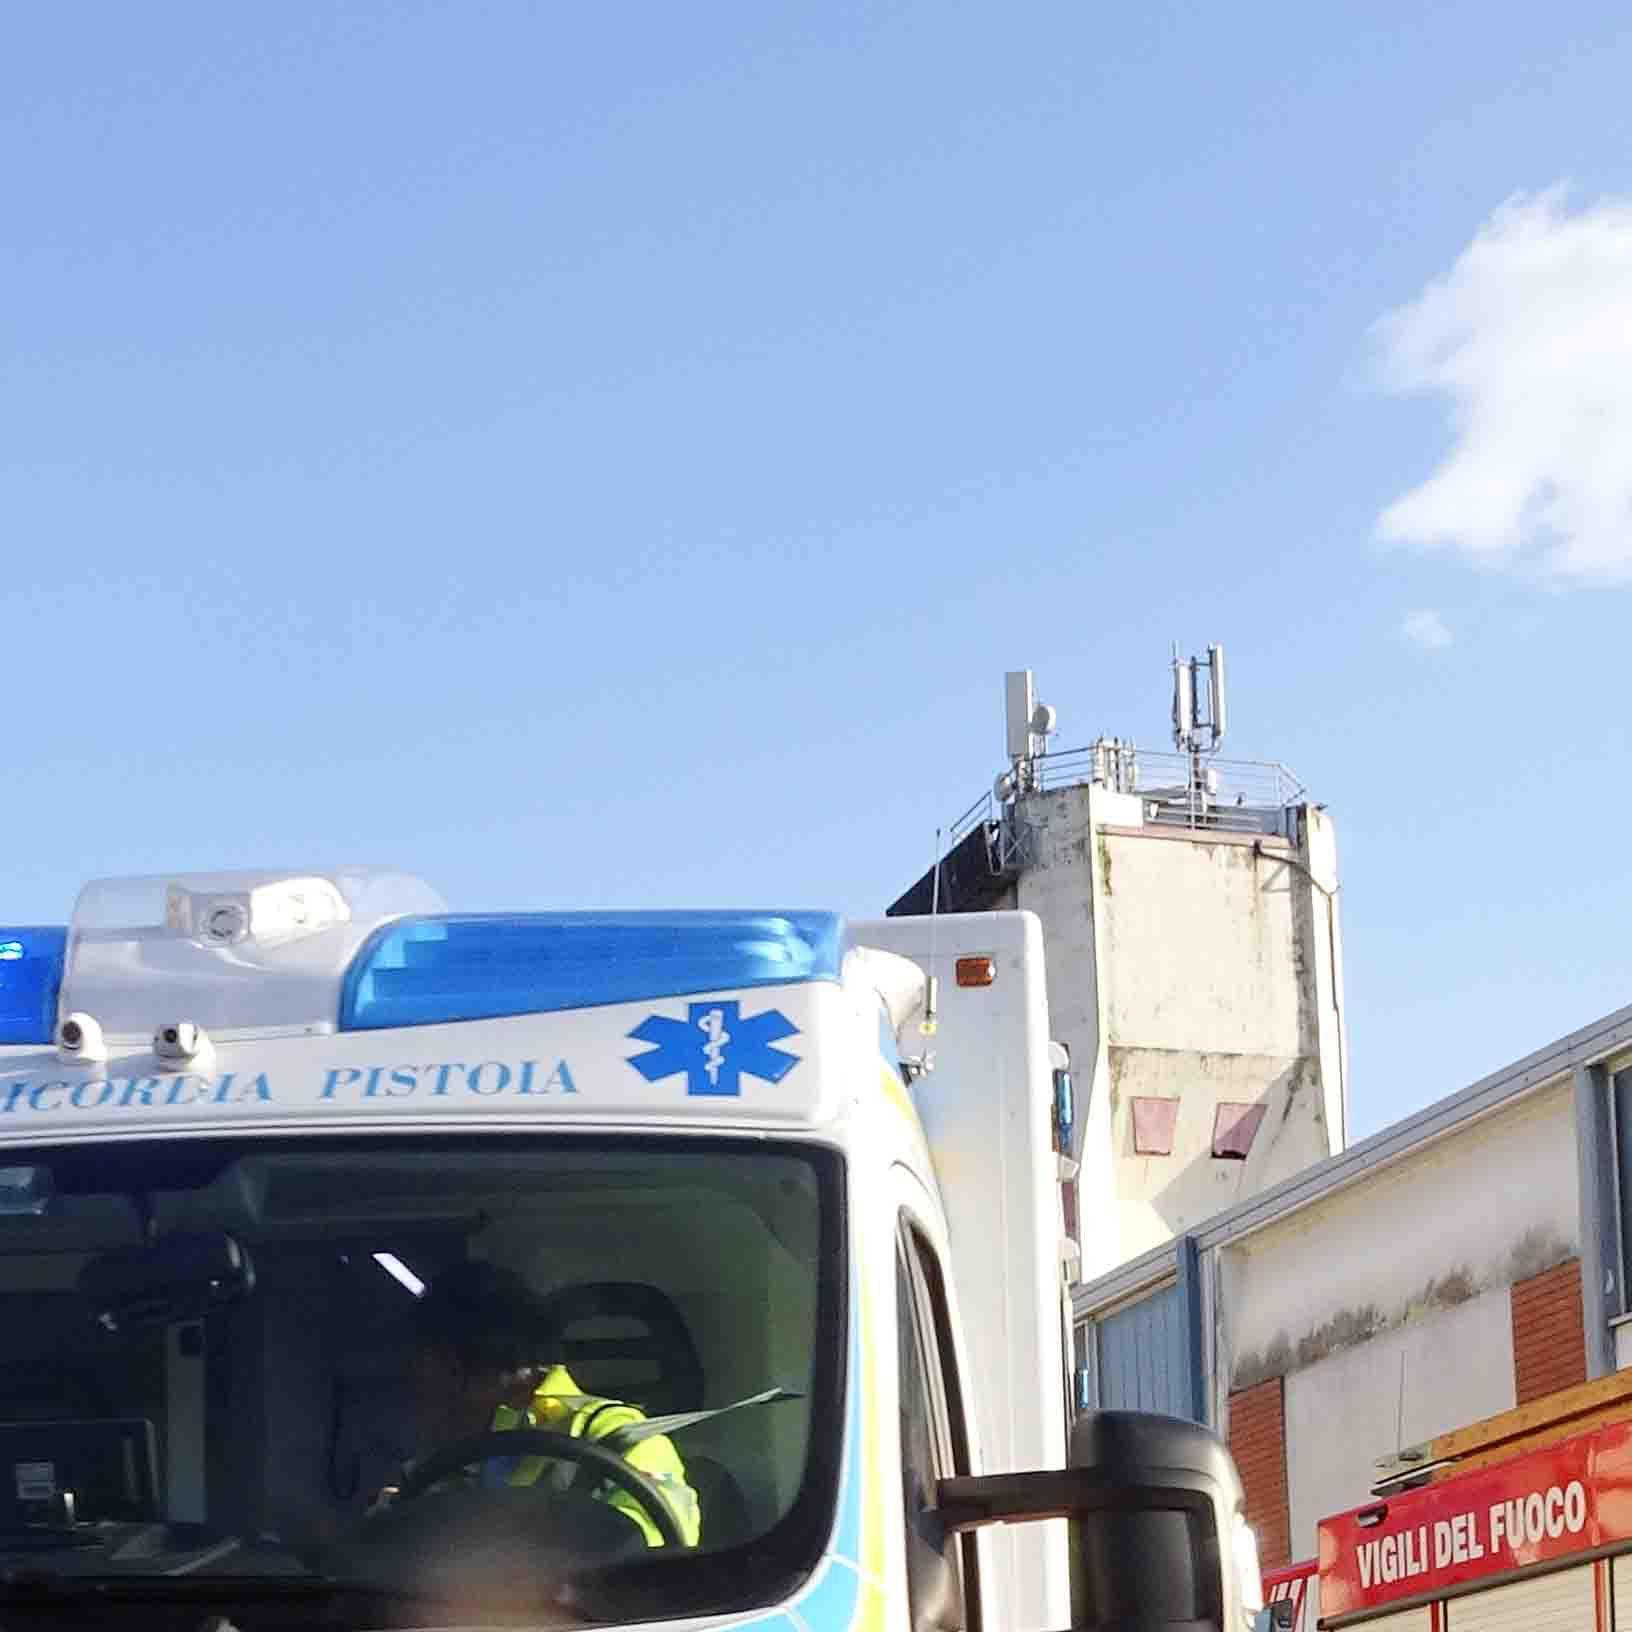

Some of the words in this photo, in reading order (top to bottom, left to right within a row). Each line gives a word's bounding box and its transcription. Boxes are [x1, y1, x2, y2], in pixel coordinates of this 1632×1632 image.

[318, 1060, 580, 1101] PISTOIA
[1356, 1528, 1426, 1588] VIGILI
[1434, 1512, 1483, 1568] DEL
[1489, 1481, 1586, 1553] FUOCO
